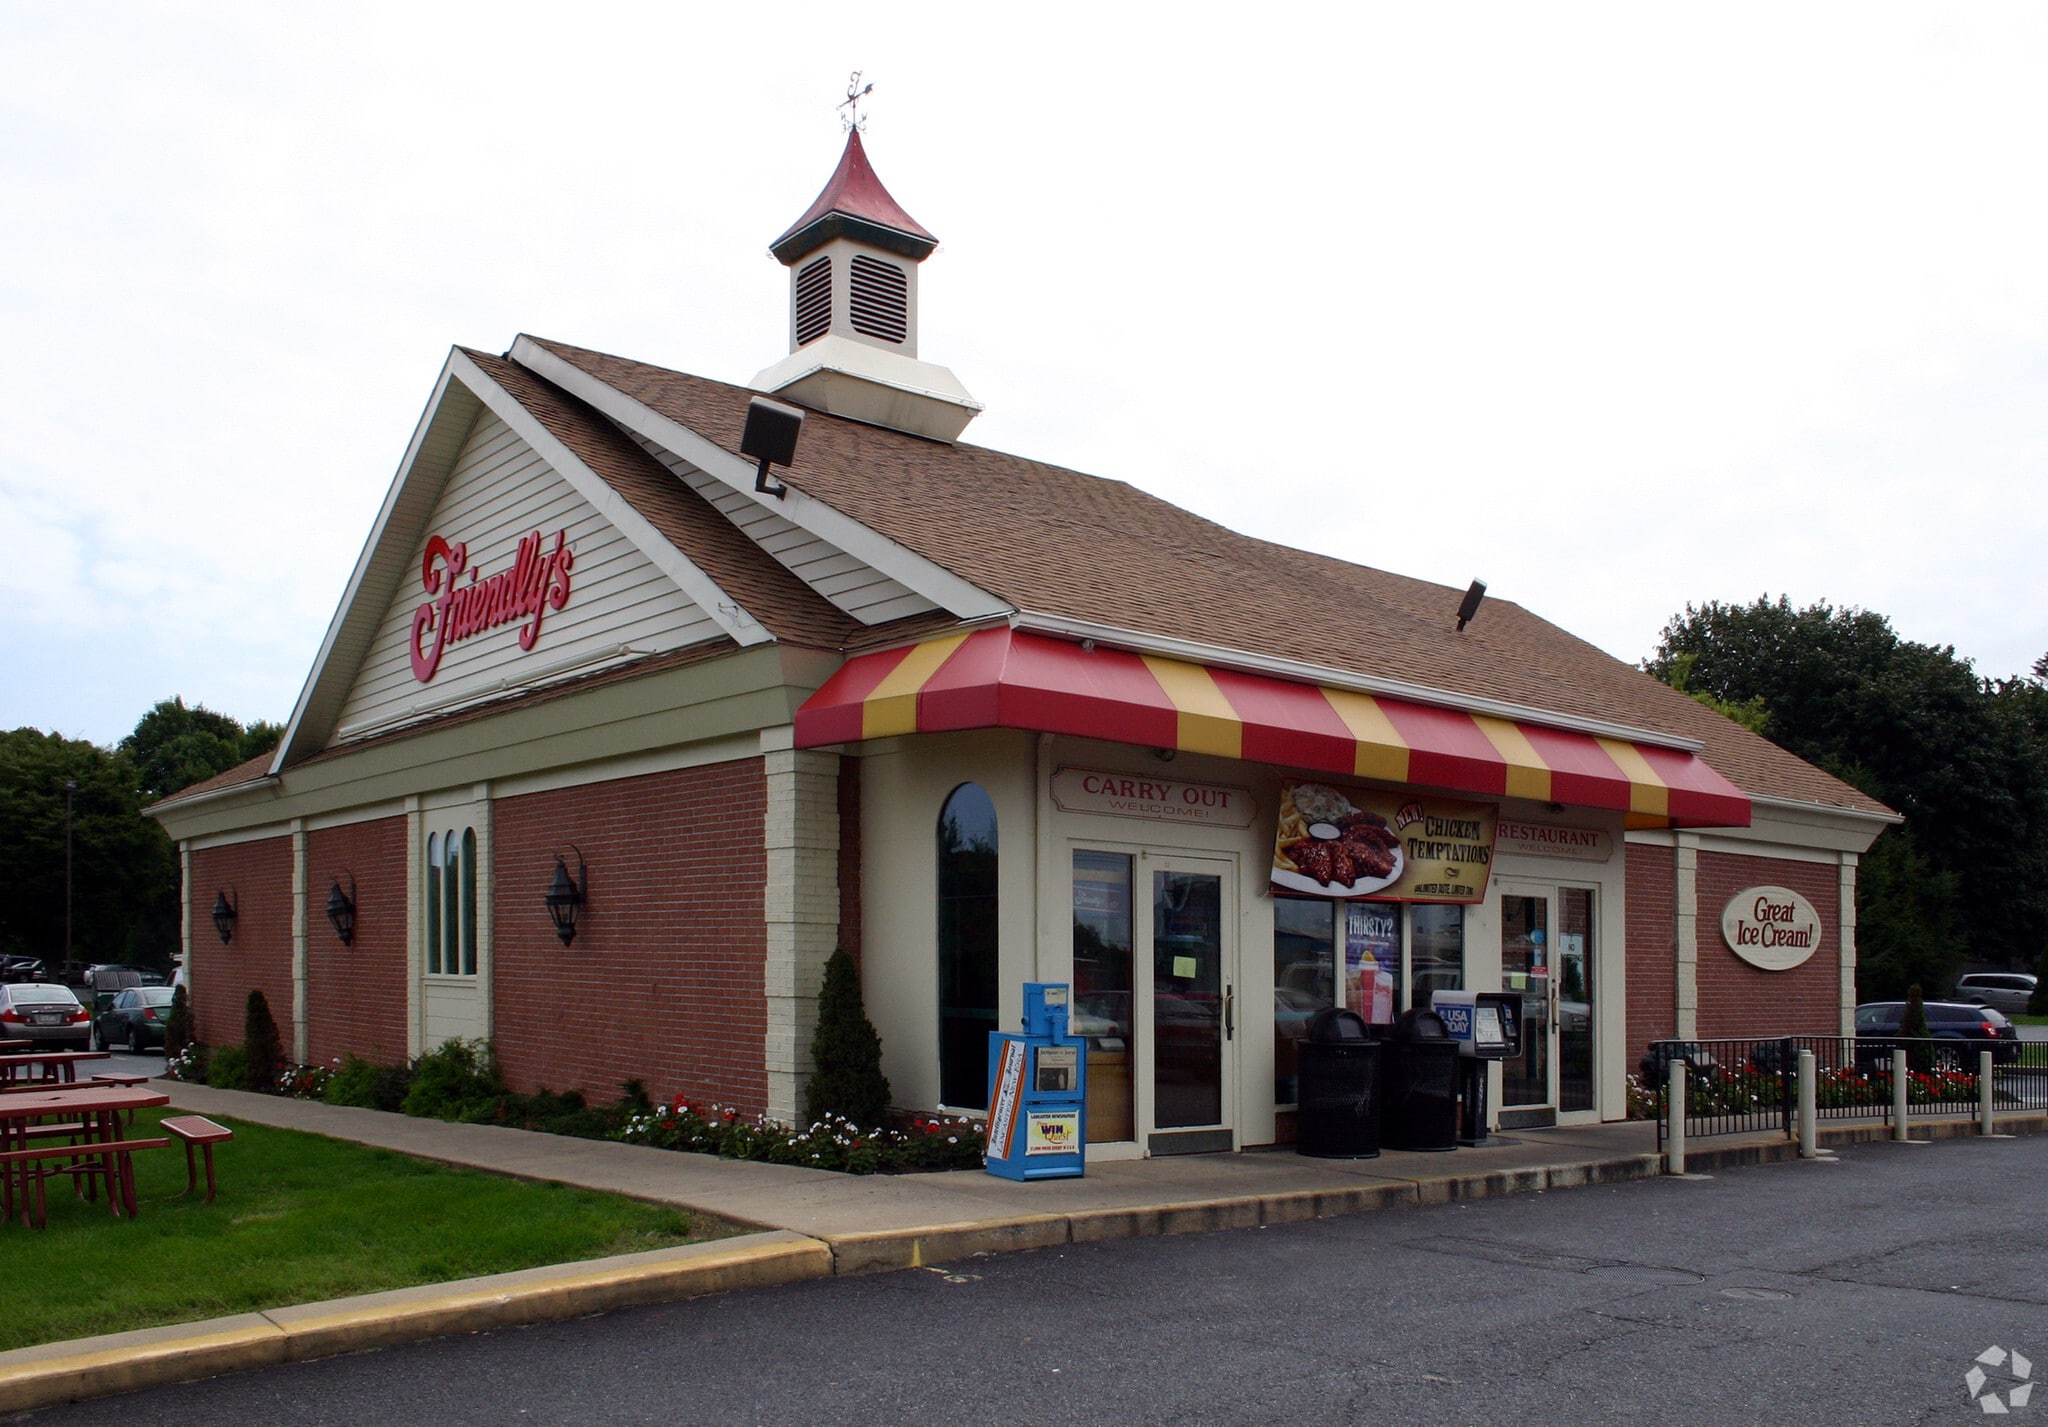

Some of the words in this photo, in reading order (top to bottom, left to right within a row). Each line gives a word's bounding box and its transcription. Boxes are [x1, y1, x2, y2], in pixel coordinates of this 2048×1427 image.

[410, 529, 573, 683] Friendly's
[1083, 775, 1171, 801] CARRY
[1182, 787, 1232, 808] OUT
[1109, 800, 1209, 818] WELCOME!
[1396, 803, 1424, 829] NEW!
[1425, 816, 1480, 840] CHICKEN
[1498, 823, 1599, 847] RESTAURANT
[1407, 837, 1490, 865] TEMPTATIONS
[1754, 896, 1795, 923] Great
[1348, 915, 1393, 938] THIRSTY?
[1737, 919, 1759, 946] Ice
[1761, 922, 1813, 948] Cream!
[1447, 1009, 1468, 1022] USA
[1041, 1124, 1064, 1135] WIN
